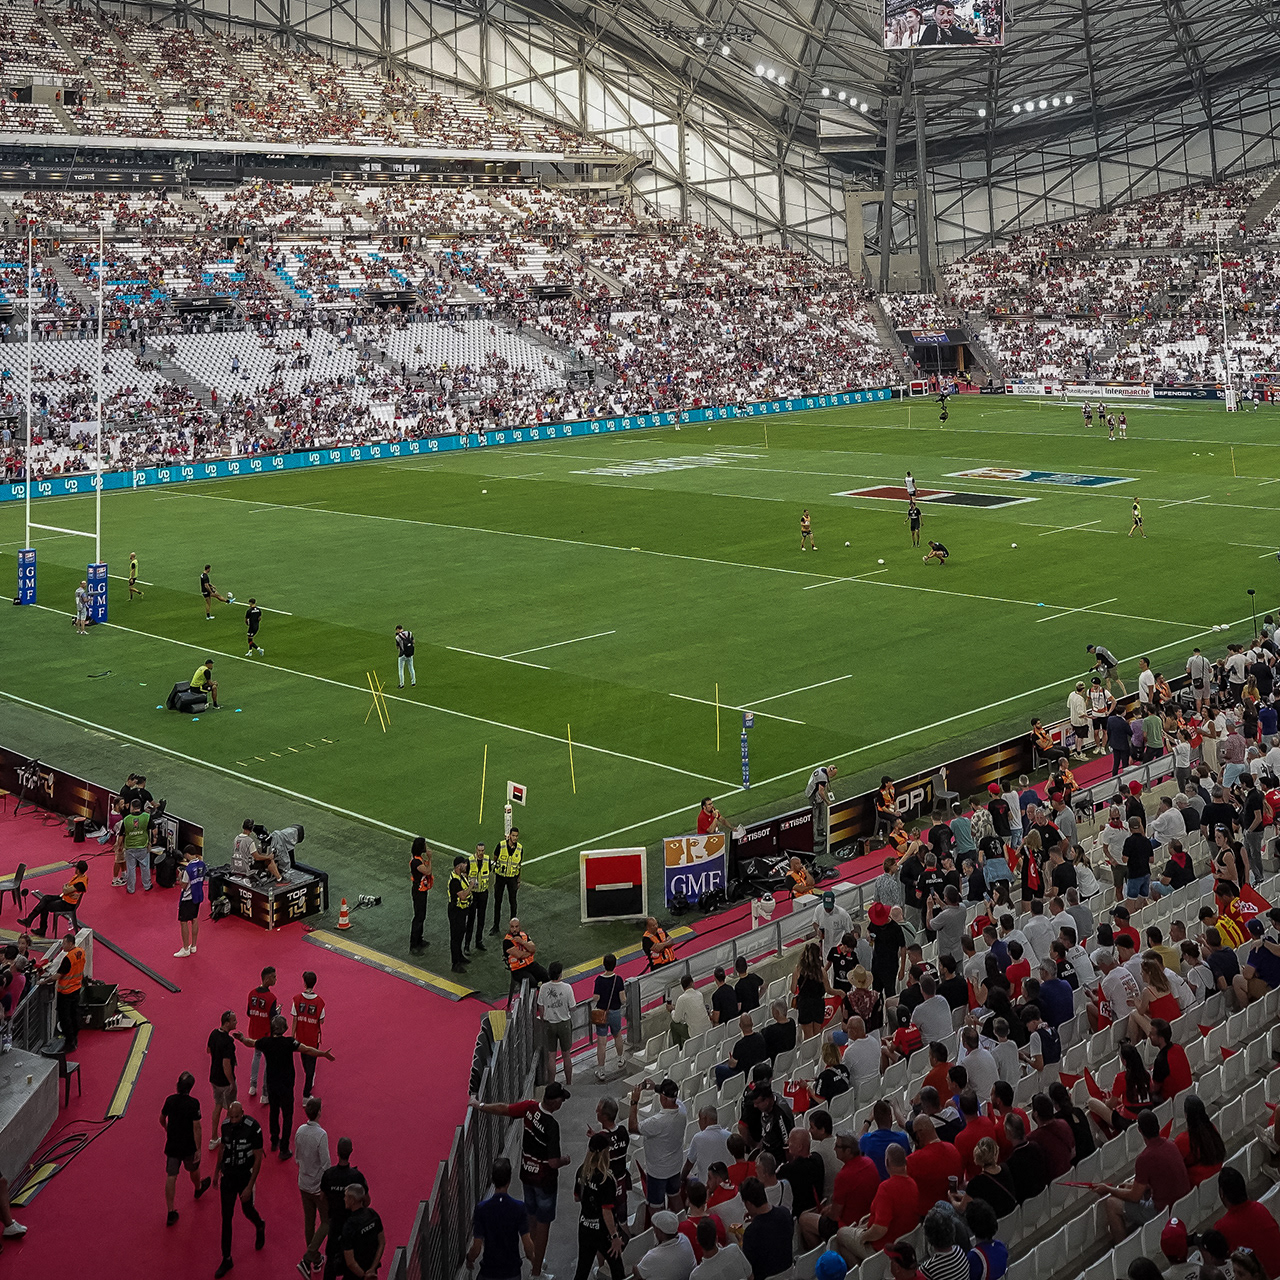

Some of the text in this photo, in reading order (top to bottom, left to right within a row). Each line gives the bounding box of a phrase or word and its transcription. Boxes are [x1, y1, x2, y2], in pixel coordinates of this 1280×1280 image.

[26, 567, 34, 600] GMF
[97, 583, 106, 618] GMF
[789, 814, 812, 827] TISSOT
[747, 827, 771, 841] TISSOT
[670, 870, 722, 896] GMF
[238, 888, 253, 899] TOP
[287, 888, 307, 900] TOP
[240, 900, 252, 918] 14
[288, 899, 307, 918] 14
